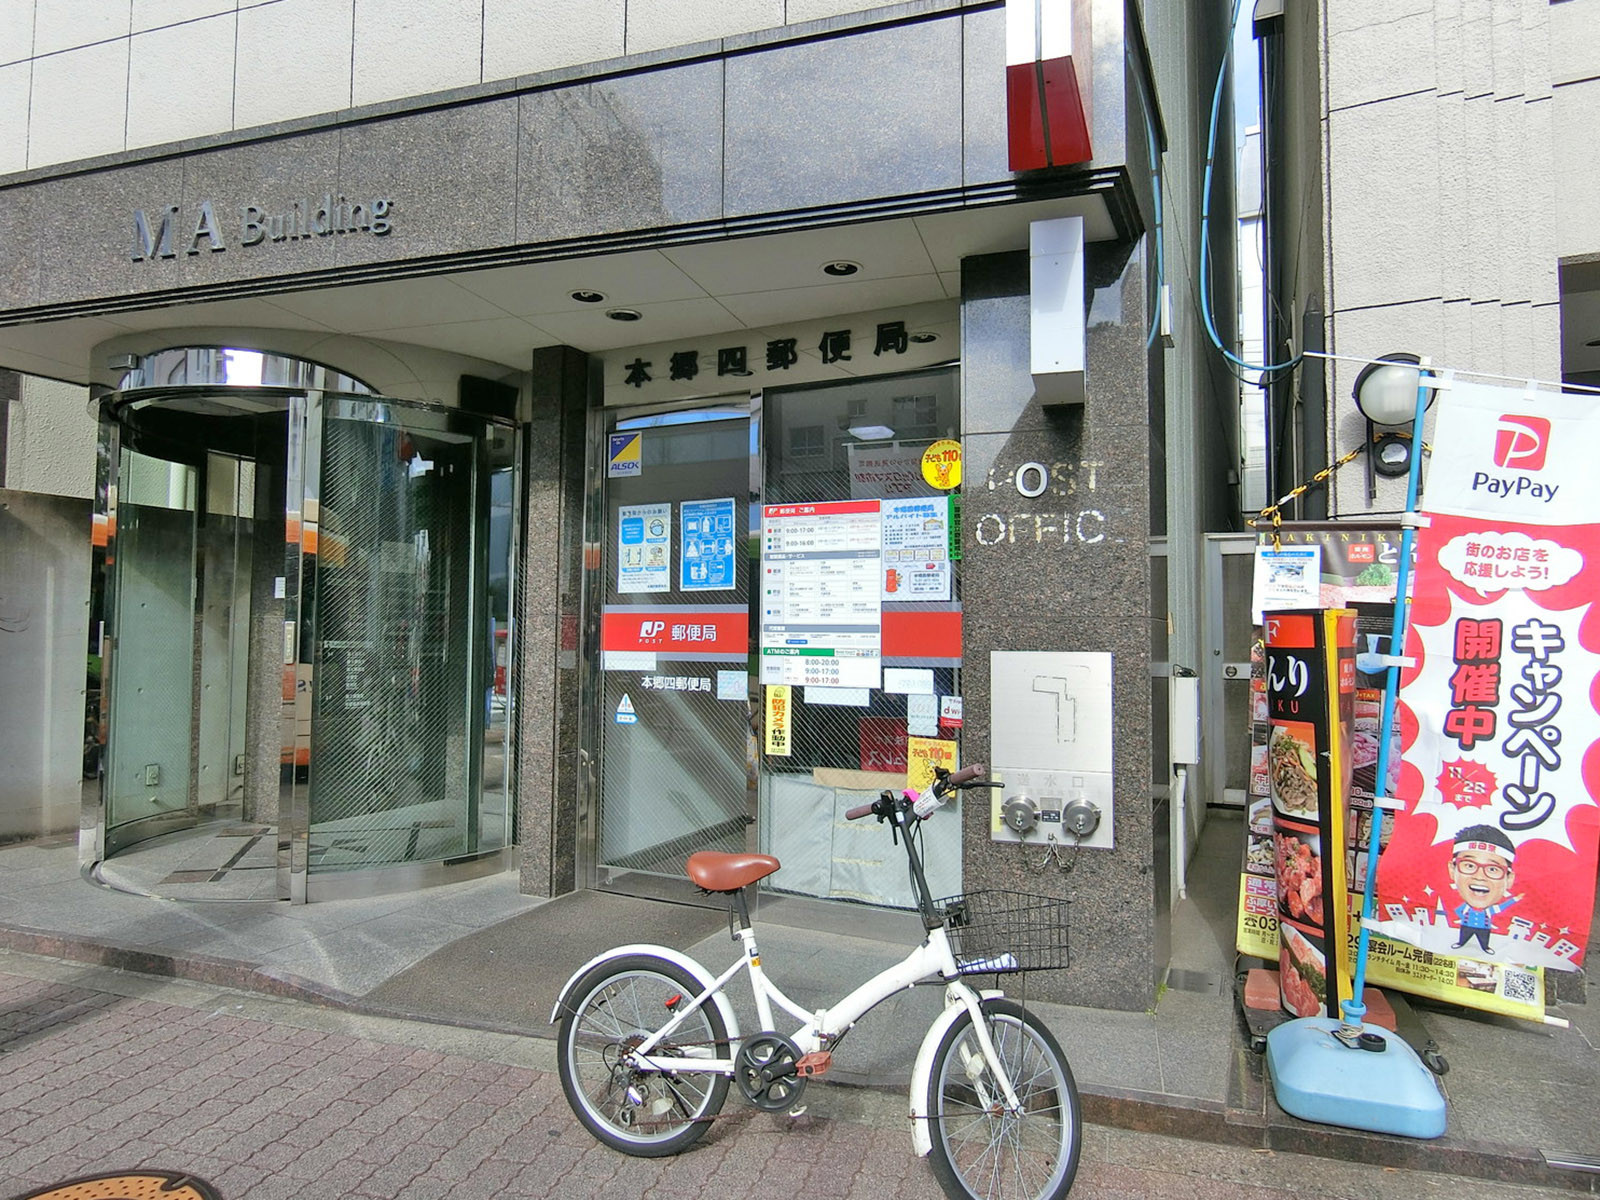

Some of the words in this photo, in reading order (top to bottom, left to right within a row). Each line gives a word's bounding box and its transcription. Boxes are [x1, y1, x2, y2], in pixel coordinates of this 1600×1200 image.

[240, 195, 394, 247] Building
[624, 321, 909, 388] 本郷四郵便局
[925, 449, 961, 464] 子ども110
[611, 462, 640, 471] ALSOK
[1472, 472, 1559, 503] PayPay
[1465, 542, 1549, 563] 街のお店を
[1463, 561, 1549, 580] 応援しよう!
[639, 620, 665, 638] JP
[671, 624, 717, 642] 郵便局
[641, 675, 712, 692] 本郷四郵便局
[1443, 617, 1503, 751] 開催中
[1500, 618, 1565, 831] キャンペーン
[1259, 916, 1277, 931] 03
[1438, 977, 1454, 985] 14:00
